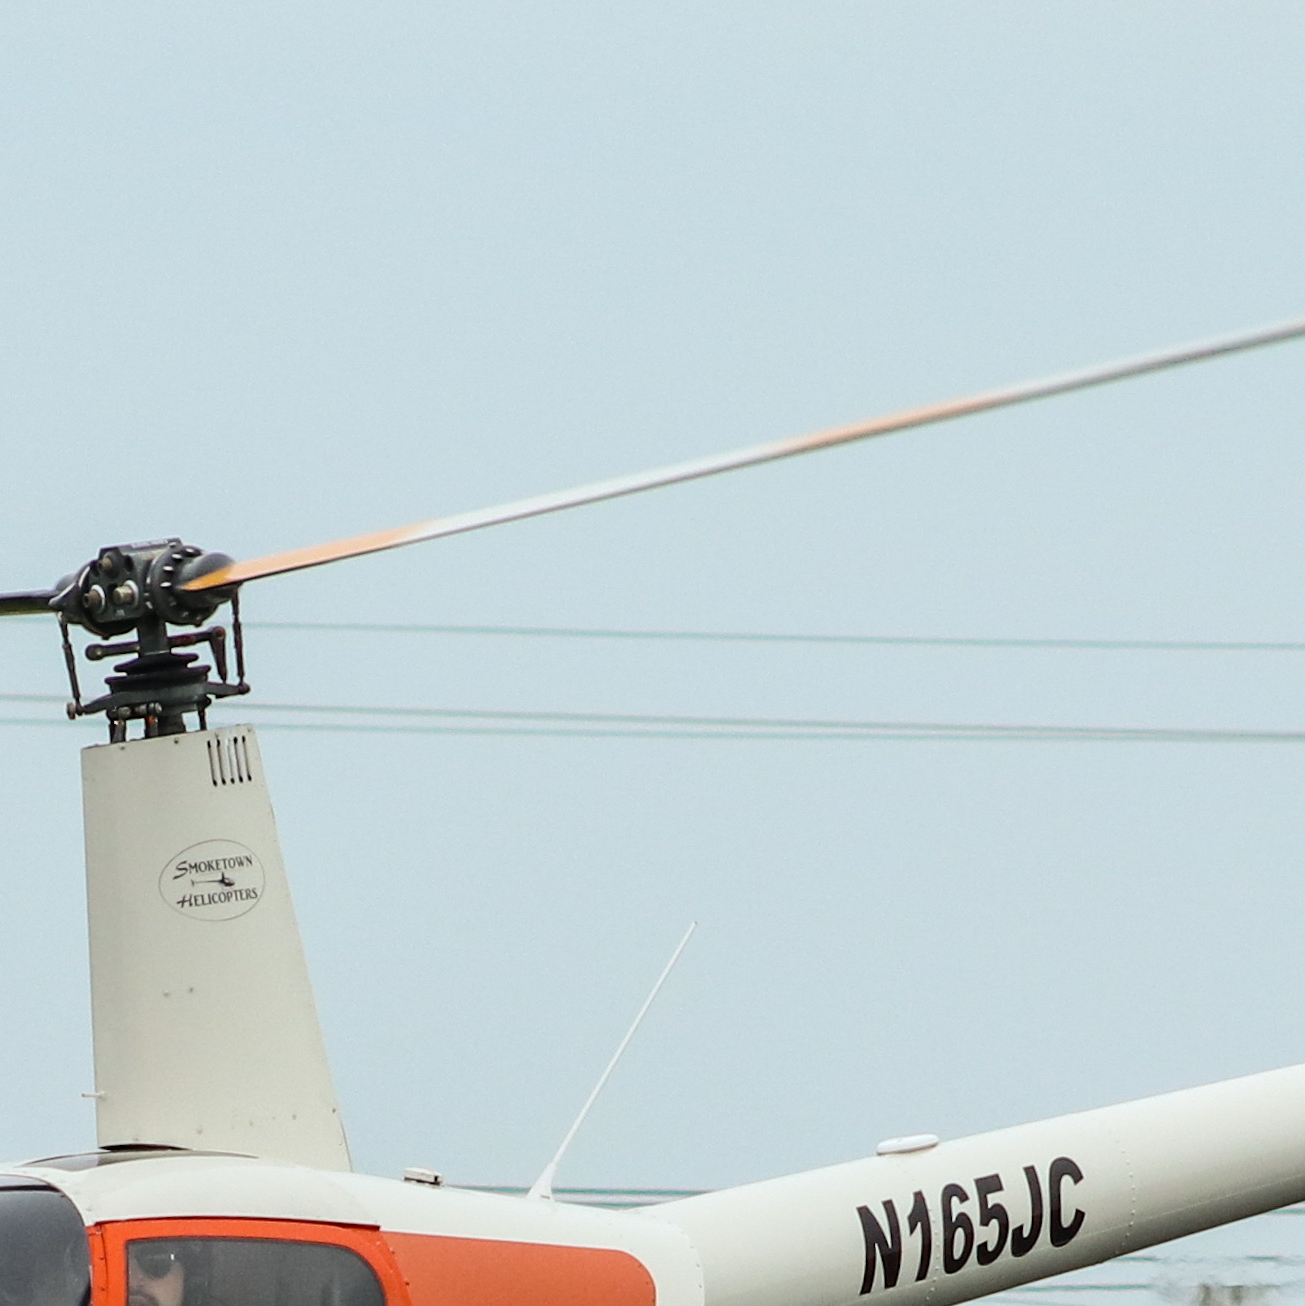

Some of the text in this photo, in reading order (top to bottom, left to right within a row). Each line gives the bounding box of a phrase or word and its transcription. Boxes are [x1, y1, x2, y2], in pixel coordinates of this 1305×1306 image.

[173, 855, 253, 880] SMOKETOWN
[176, 887, 258, 908] HELICOPTERS
[856, 1156, 1086, 1296] N165JC
